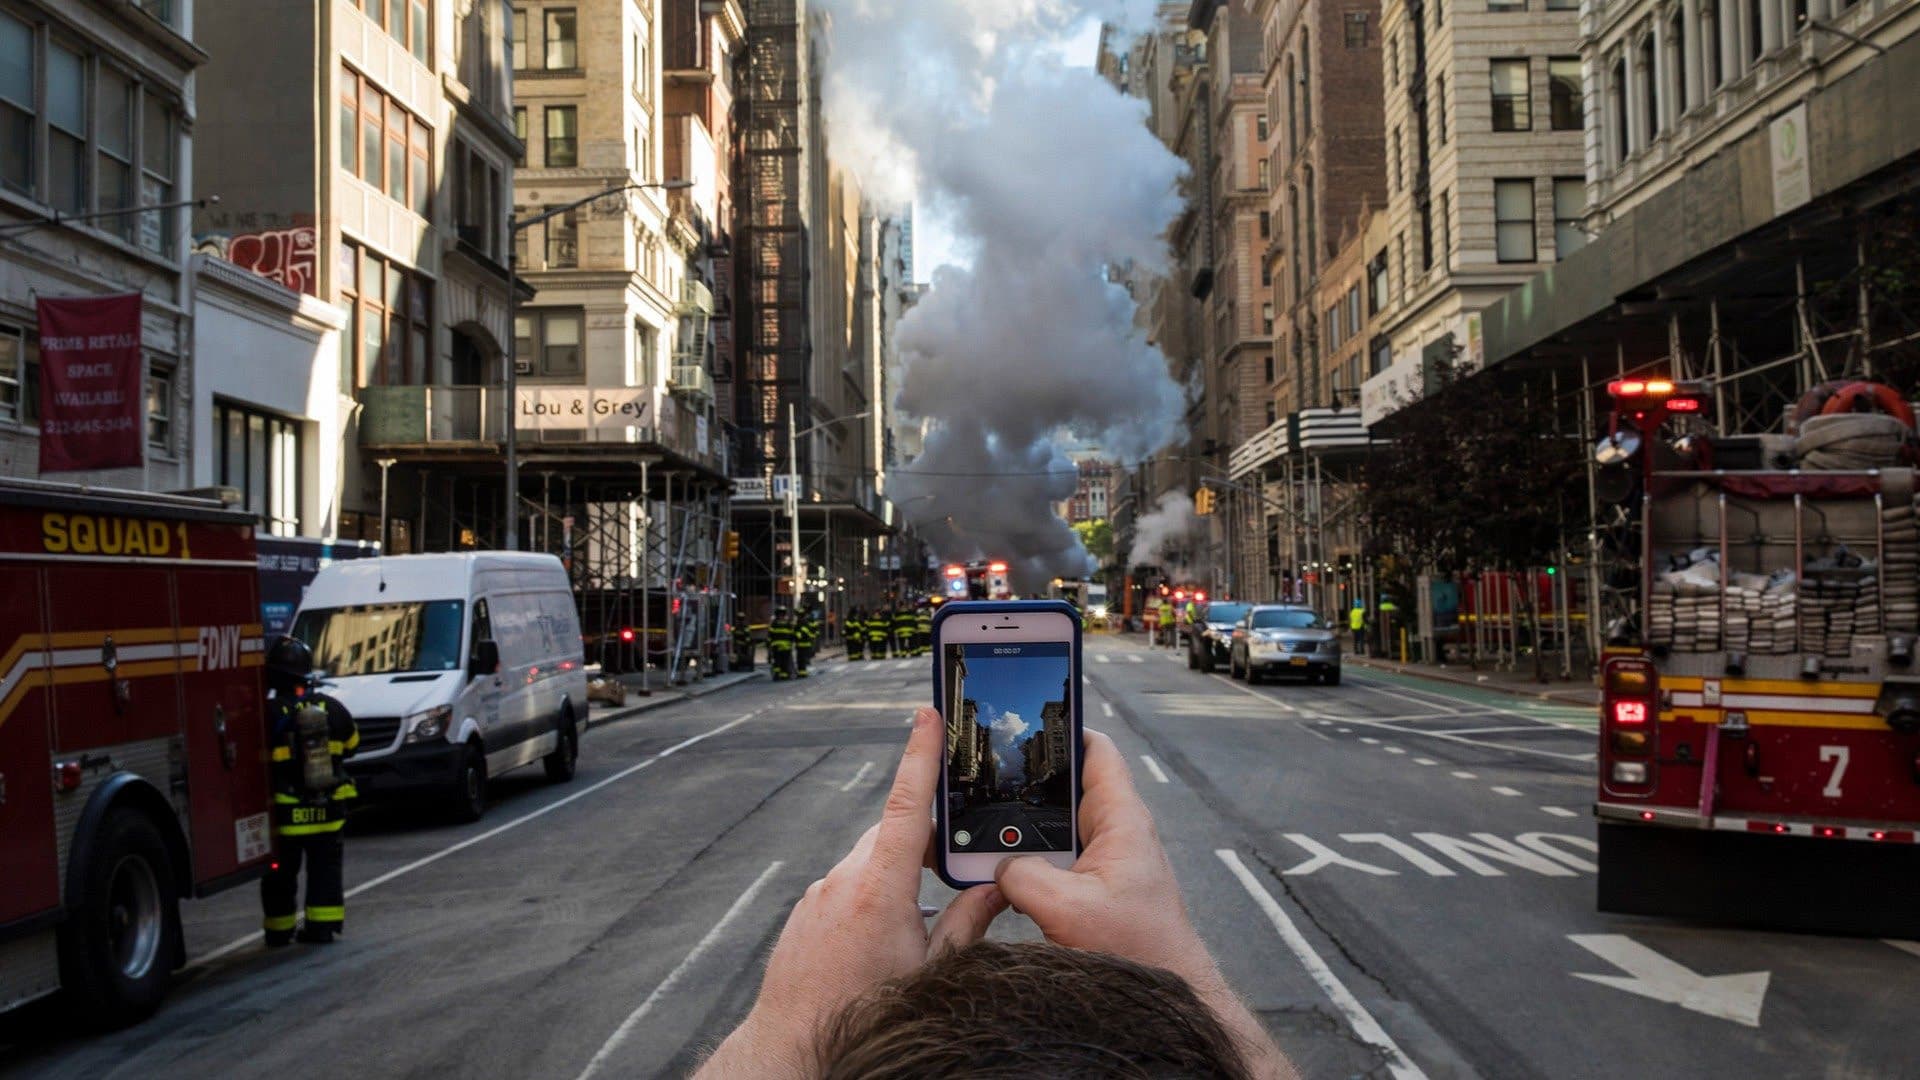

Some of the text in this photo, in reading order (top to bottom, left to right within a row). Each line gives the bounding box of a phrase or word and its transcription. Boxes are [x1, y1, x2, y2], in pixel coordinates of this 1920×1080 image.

[40, 336, 84, 351] PRIME
[67, 363, 113, 378] SPACE
[522, 399, 647, 418] Lou & Grey
[42, 512, 191, 560] SQUAD 1
[197, 623, 241, 672] FDNY
[1819, 745, 1850, 798] 7
[1282, 831, 1599, 877] ONLY
